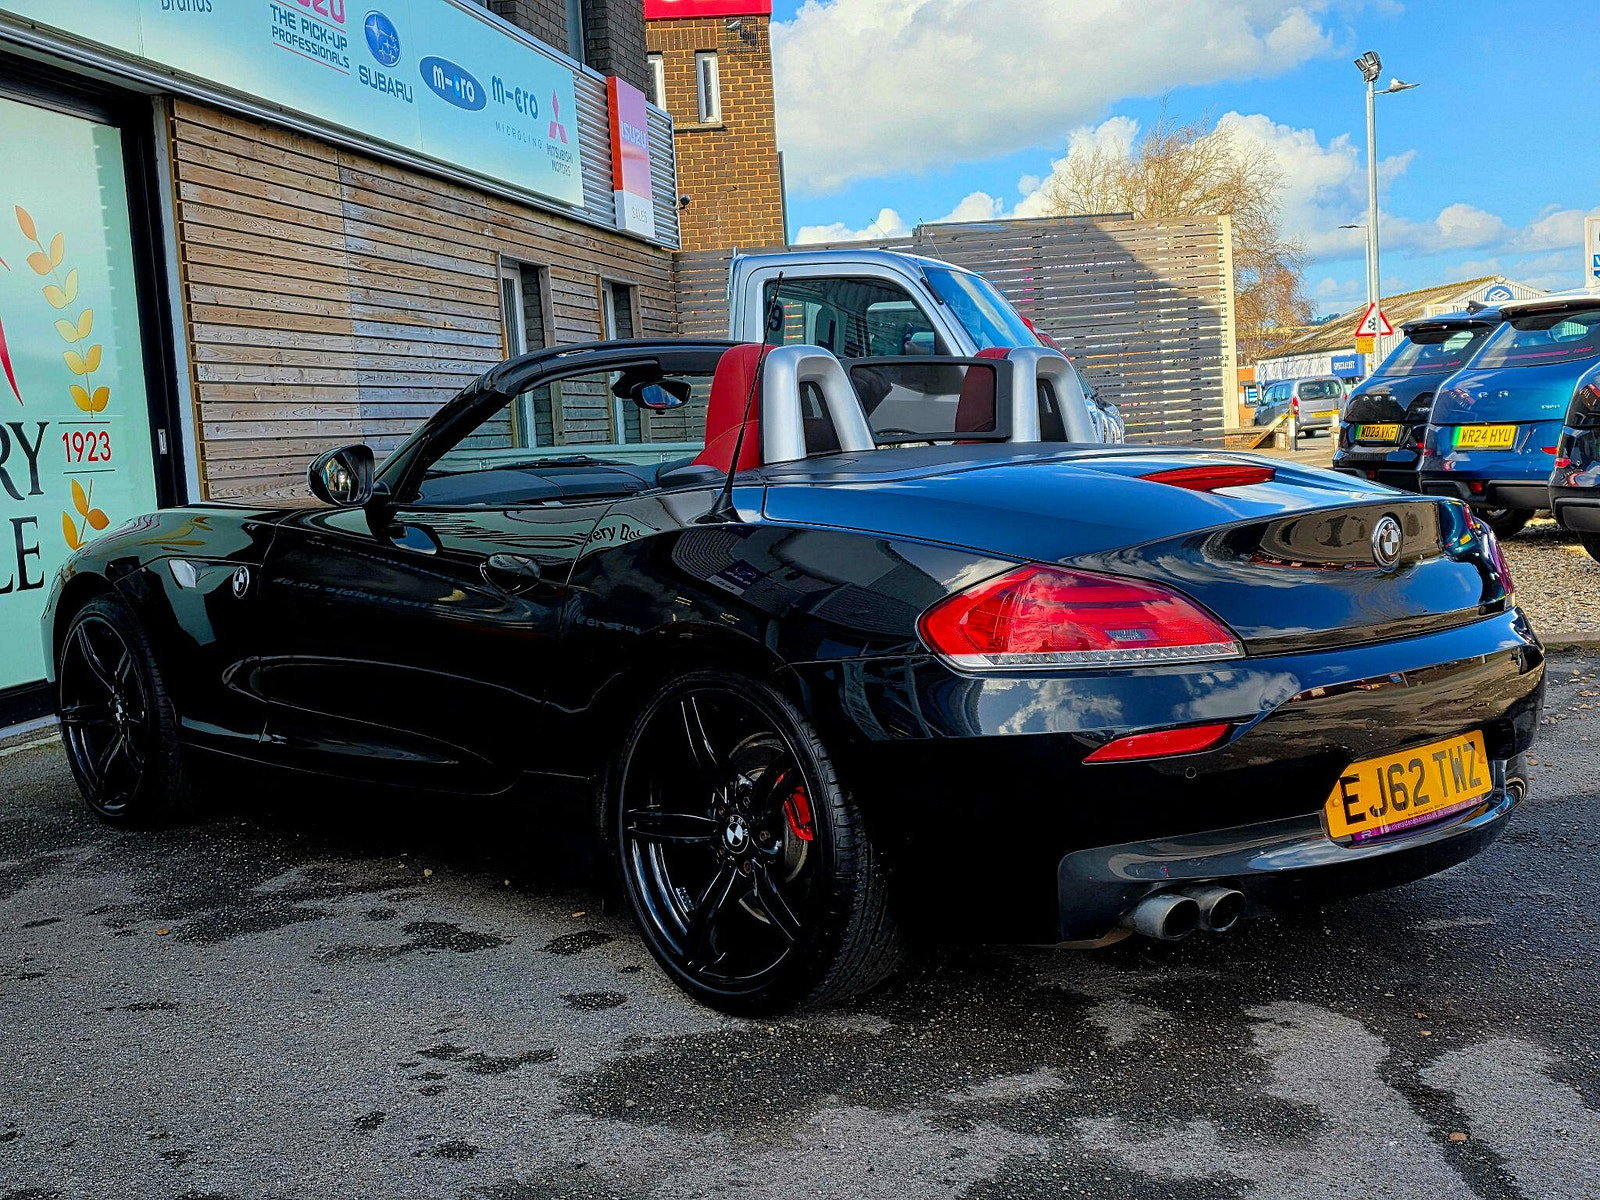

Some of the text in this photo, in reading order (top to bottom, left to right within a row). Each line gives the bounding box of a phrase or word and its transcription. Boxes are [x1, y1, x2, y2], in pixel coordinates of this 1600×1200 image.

[269, 4, 348, 51] THE PICK-UP
[271, 25, 350, 69] PROFESSIONALS
[358, 64, 414, 104] SUBARU
[620, 122, 648, 149] ISUZU
[62, 430, 112, 463] 1923
[1460, 427, 1513, 444] WR24 HYU
[1339, 757, 1431, 826] EJ62
[1431, 741, 1481, 798] TWZ
